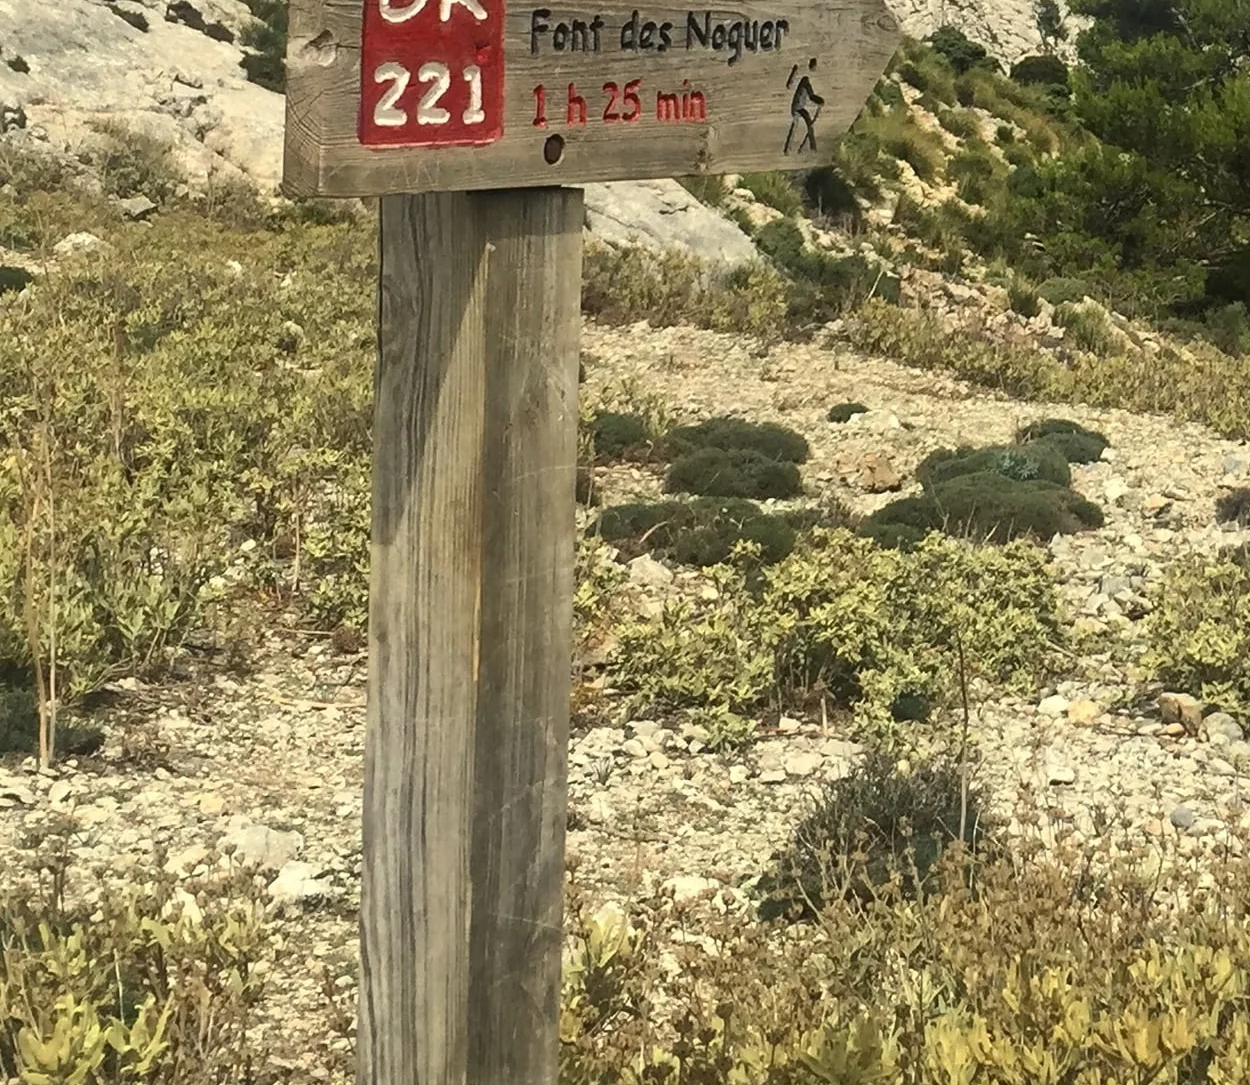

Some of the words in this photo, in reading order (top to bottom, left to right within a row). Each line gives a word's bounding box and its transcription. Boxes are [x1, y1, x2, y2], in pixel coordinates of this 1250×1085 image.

[531, 8, 605, 56] Font
[621, 9, 673, 52] des
[686, 11, 789, 66] Noguer
[373, 61, 485, 127] 221
[532, 83, 549, 128] 1
[567, 82, 587, 127] h
[602, 77, 643, 124] 25
[656, 79, 706, 124] min
